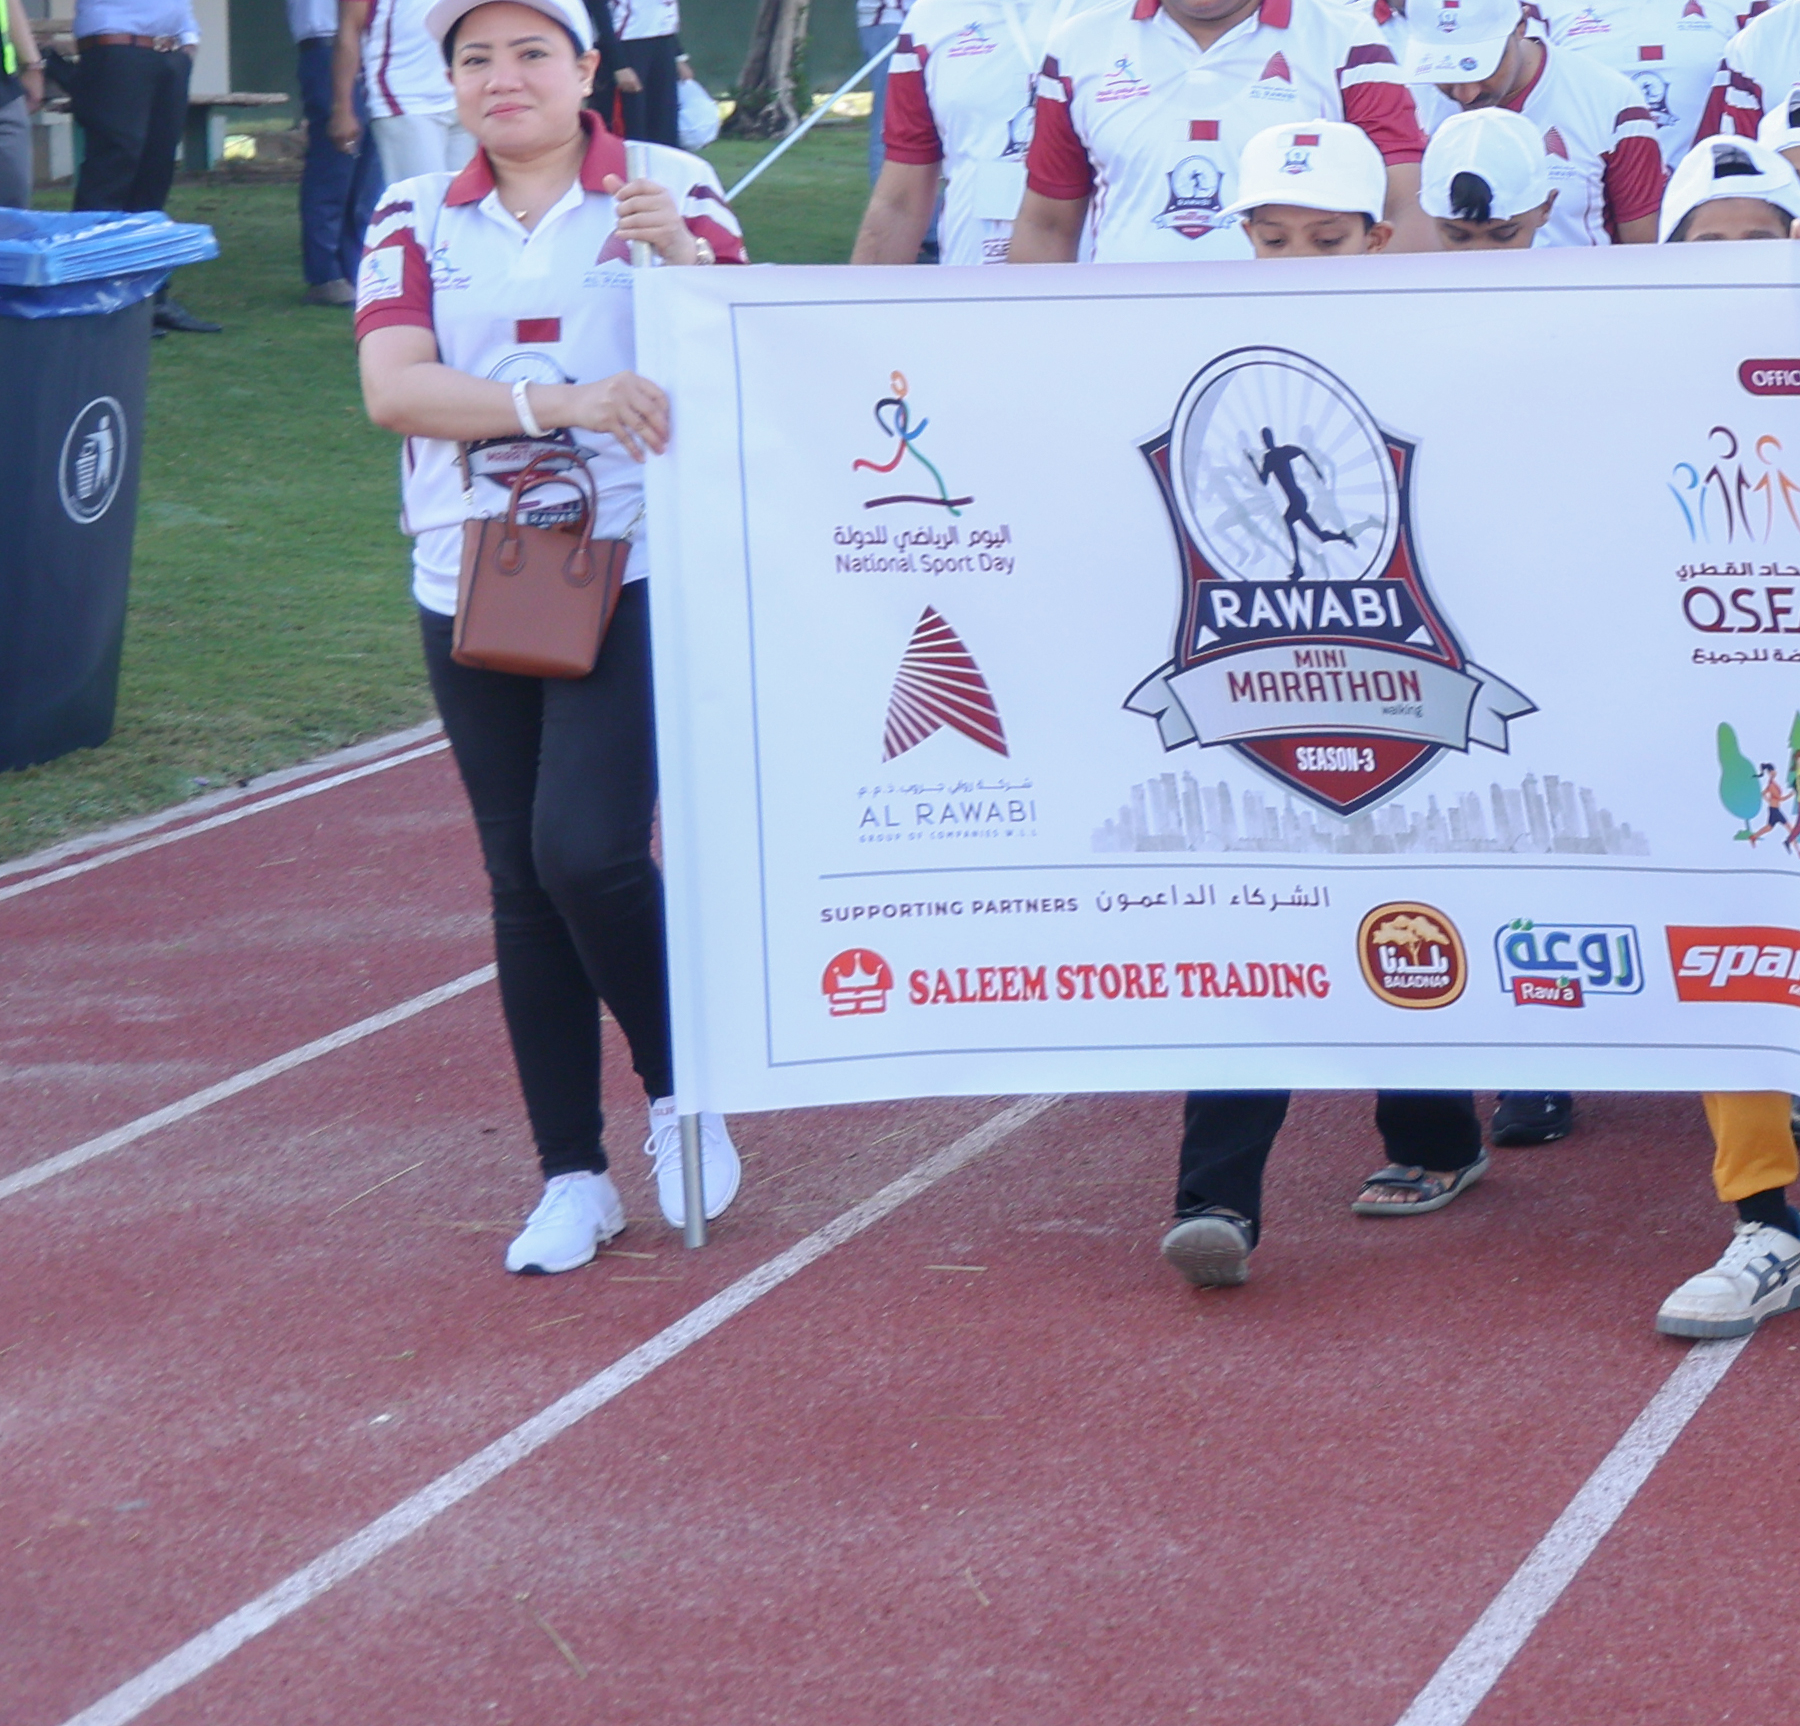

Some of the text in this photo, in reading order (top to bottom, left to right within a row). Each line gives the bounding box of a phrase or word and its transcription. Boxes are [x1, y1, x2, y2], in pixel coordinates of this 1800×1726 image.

[835, 553, 1015, 575] National Sport Day
[1209, 587, 1403, 630] RAWABI
[1293, 649, 1347, 668] MINI
[1226, 670, 1422, 702] MARATHON
[1295, 746, 1377, 772] SEASON-3
[858, 799, 1036, 829] AL RAWABI
[820, 896, 1079, 923] SUPPORTING PARTNERS
[1095, 884, 1331, 913] الشركاء الداعمون
[1378, 945, 1449, 974] بلدنا
[1504, 918, 1636, 987] روعة
[909, 962, 1331, 1006] SALEEM STORE TRADING
